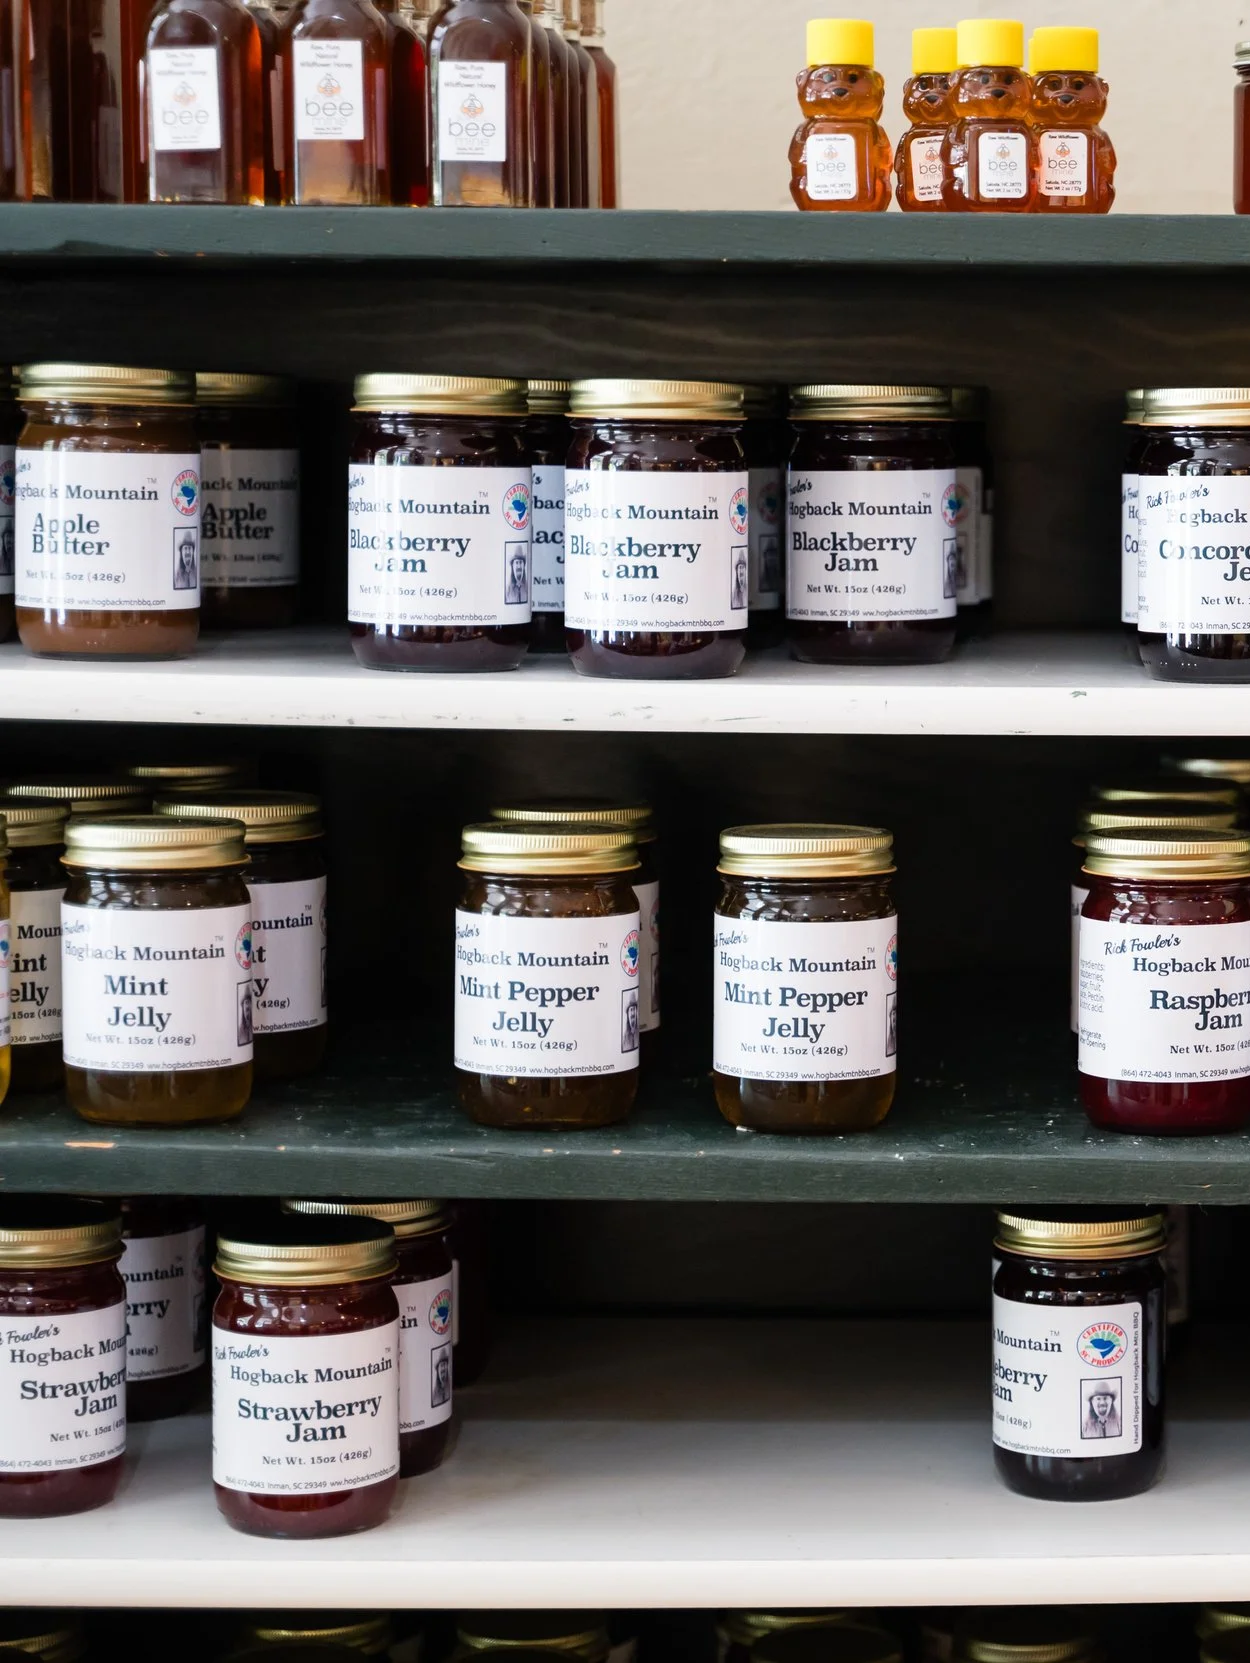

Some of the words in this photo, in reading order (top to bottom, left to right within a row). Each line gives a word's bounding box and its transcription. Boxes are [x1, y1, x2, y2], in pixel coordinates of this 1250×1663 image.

[305, 98, 354, 116] bee
[162, 109, 209, 125] bee
[449, 118, 496, 137] bee
[988, 159, 1017, 170] bee
[1048, 157, 1077, 169] bee
[66, 486, 158, 500] Mountain
[201, 503, 266, 525] Apple
[399, 499, 490, 515] Mountain
[628, 505, 719, 520] Mountain
[848, 501, 932, 516] Mountain
[32, 513, 100, 538] Apple
[201, 522, 274, 540] Butter
[32, 533, 110, 555] Butter
[793, 532, 917, 555] Blackberry
[824, 553, 879, 571] Jam
[88, 572, 126, 584] (426g)
[807, 584, 821, 593] Net
[824, 585, 841, 593] Wt.
[845, 585, 868, 593] 15oz
[872, 584, 906, 594] (426g)
[651, 593, 689, 604] (426g)
[1201, 596, 1220, 605] Net
[1225, 596, 1245, 605] Wt.
[251, 913, 313, 931] ountain
[719, 930, 748, 947] Fowler's
[1104, 940, 1127, 955] Rick
[1130, 934, 1181, 952] Fowler's
[133, 944, 225, 961] Mountain
[457, 944, 511, 966] Hogback
[518, 952, 609, 967] Mountain
[720, 952, 782, 973] Hogback
[789, 956, 876, 973] Mountain
[1132, 957, 1216, 977] Hogback
[104, 975, 168, 996] Mint
[460, 975, 501, 999] Mint
[508, 981, 599, 1008] Pepper
[256, 998, 290, 1009] (426g)
[724, 982, 773, 1006] Mint
[779, 987, 868, 1013] Pepper
[107, 1006, 172, 1032] Jelly
[493, 1011, 554, 1039] Jelly
[1195, 1011, 1242, 1031] Jam
[762, 1017, 825, 1044] Jelly
[128, 1036, 154, 1045] 15oz
[157, 1034, 196, 1048] (426g)
[511, 1041, 536, 1049] 15oz
[540, 1040, 578, 1051] (426g)
[1170, 1045, 1190, 1054] Net
[1194, 1045, 1212, 1053] Wt.
[1215, 1043, 1235, 1052] 15oz
[1121, 1069, 1137, 1077] (864)
[1139, 1070, 1172, 1078] 472-4043
[1132, 1312, 1140, 1329] BBQ
[8, 1324, 61, 1345] Fowler's
[1082, 1323, 1124, 1339] CERTIFIED
[997, 1330, 1062, 1354] Mountain
[10, 1343, 95, 1367] Hogback
[228, 1344, 270, 1360] Fowler's
[230, 1365, 308, 1386] Hogback
[314, 1357, 393, 1383] Mountain
[1132, 1348, 1141, 1381] Hogback
[74, 1393, 118, 1417] Jam
[238, 1395, 382, 1421] Strawberry
[1132, 1395, 1141, 1423] Dipped
[286, 1423, 347, 1443] Jam
